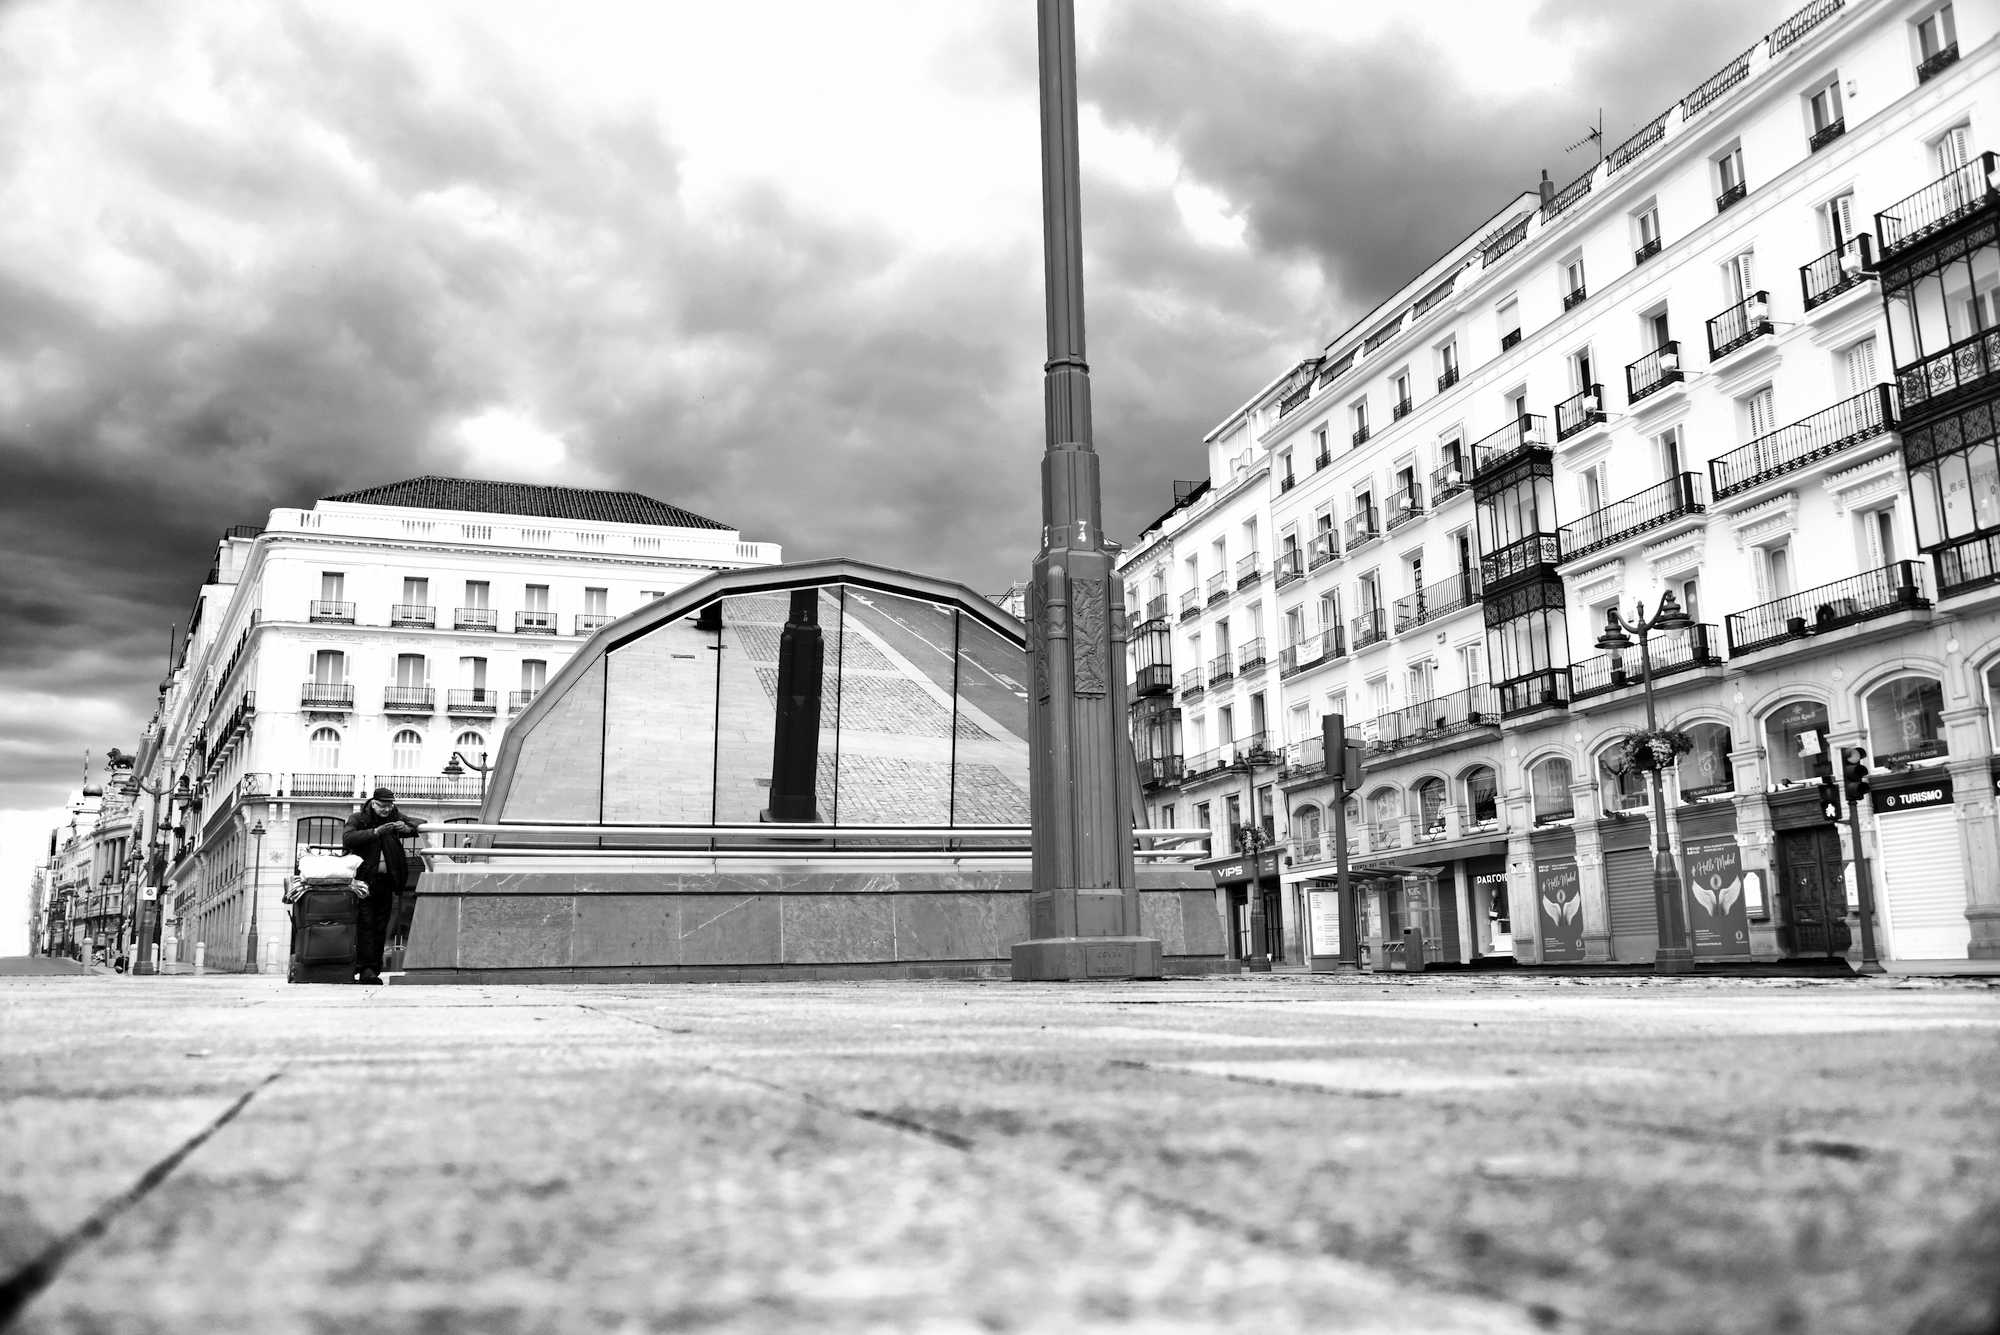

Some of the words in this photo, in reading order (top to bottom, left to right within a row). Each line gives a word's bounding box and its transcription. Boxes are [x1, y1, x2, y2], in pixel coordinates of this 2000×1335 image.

[1078, 520, 1087, 542] 74
[1899, 789, 1943, 804] TURISMO
[1714, 852, 1735, 871] Madrid
[1217, 866, 1243, 878] VIPS
[1560, 871, 1576, 887] Madrid
[1096, 965, 1124, 973] MADRID
